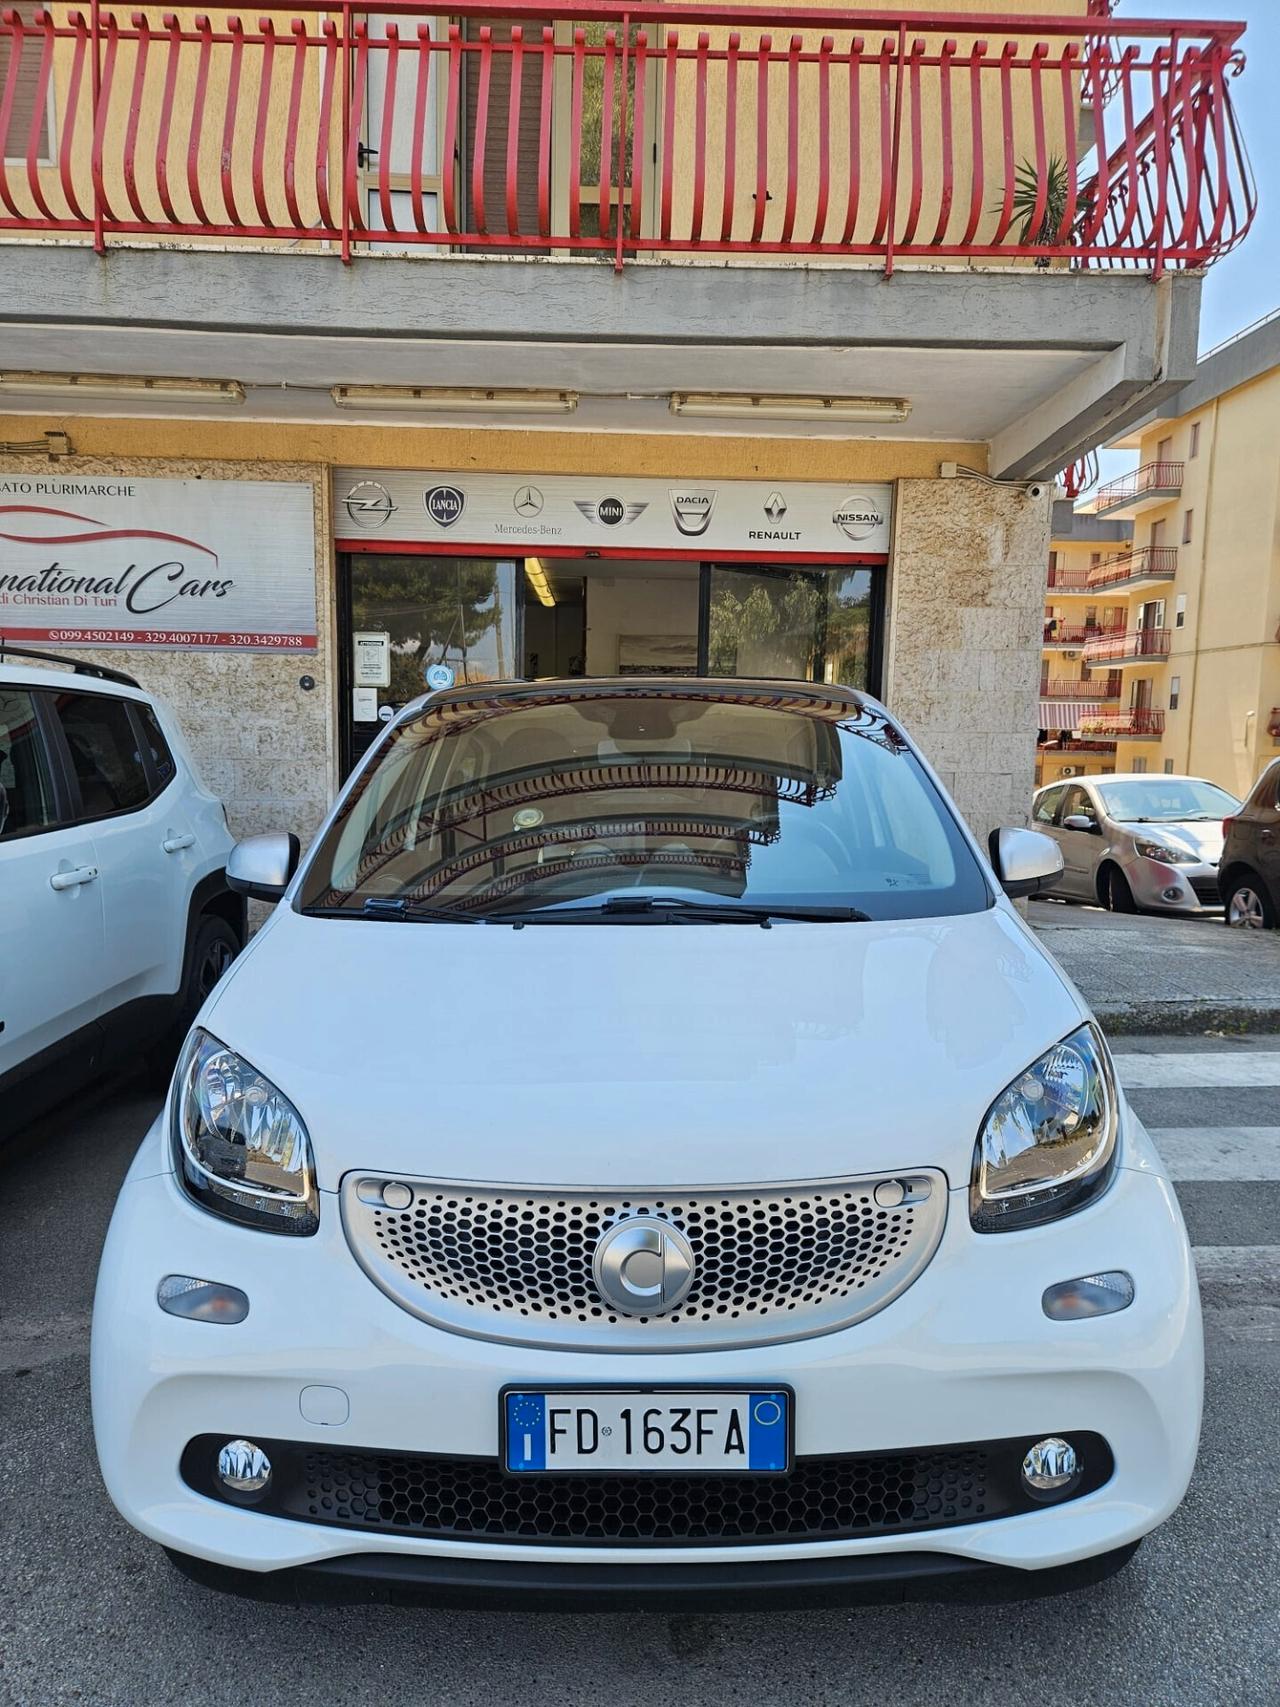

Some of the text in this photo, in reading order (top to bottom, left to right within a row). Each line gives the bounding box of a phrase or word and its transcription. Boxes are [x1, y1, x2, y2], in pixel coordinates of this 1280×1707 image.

[0, 482, 136, 497] ATO PLURIMARCHE
[432, 499, 458, 511] LANCIA
[676, 496, 709, 504] DACIA
[599, 505, 623, 516] MINI
[837, 513, 879, 522] NISSAN
[495, 524, 562, 536] Mercedes-Benz
[749, 531, 802, 541] RENAULT
[125, 561, 236, 614] Cars
[13, 593, 69, 606] Christian
[74, 595, 87, 606] Di
[92, 595, 117, 606] Turi
[60, 630, 134, 642] 099.4502149
[145, 632, 218, 644] 329.4007177
[229, 634, 302, 646] 320.3429788
[549, 1408, 745, 1454] FD 163FA
